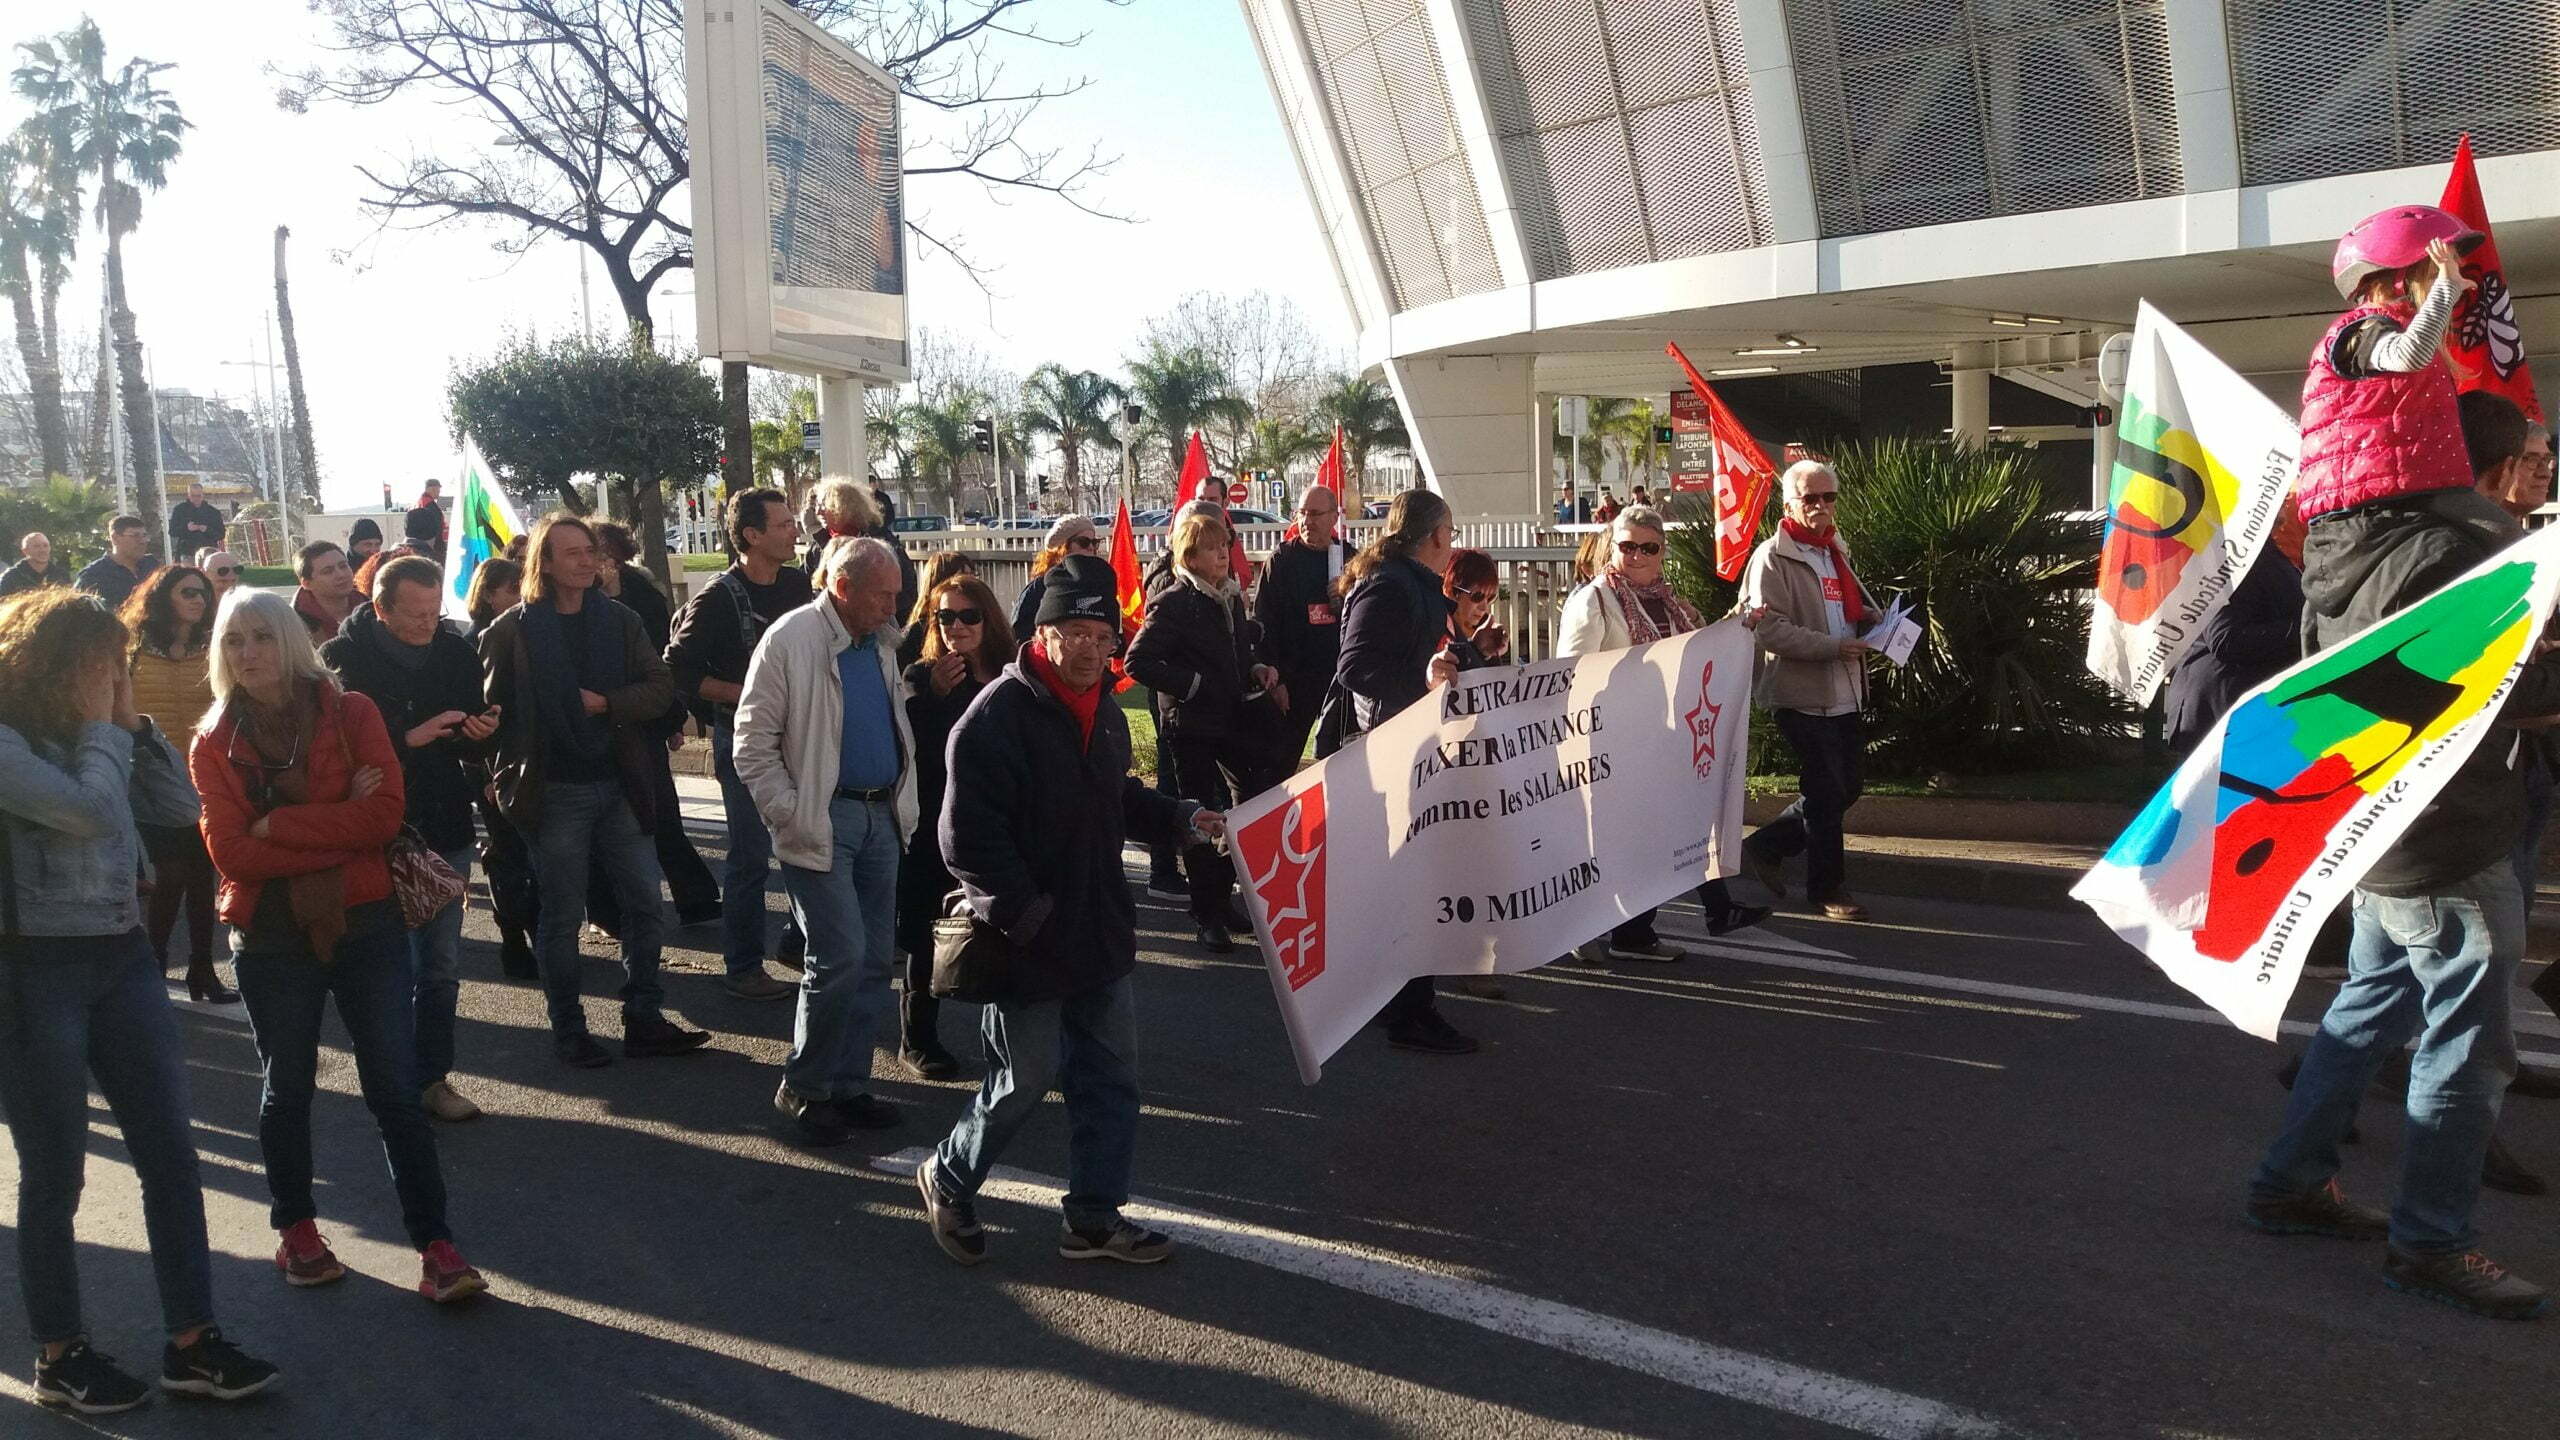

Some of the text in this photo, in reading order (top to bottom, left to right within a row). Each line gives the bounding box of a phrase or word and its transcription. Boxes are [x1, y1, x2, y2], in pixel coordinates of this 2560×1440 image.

[1675, 440, 1713, 450] LAFONTAN
[1679, 432, 1709, 442] TRIBUNE
[1681, 459, 1707, 469] ENTRÉE
[1698, 718, 1710, 737] 83
[1414, 705, 1603, 790] TAXER la FINANCE
[1697, 760, 1712, 781] PCF
[1406, 752, 1612, 843] comme les SALAIRES
[1436, 856, 1601, 924] 30 MILLIARDS
